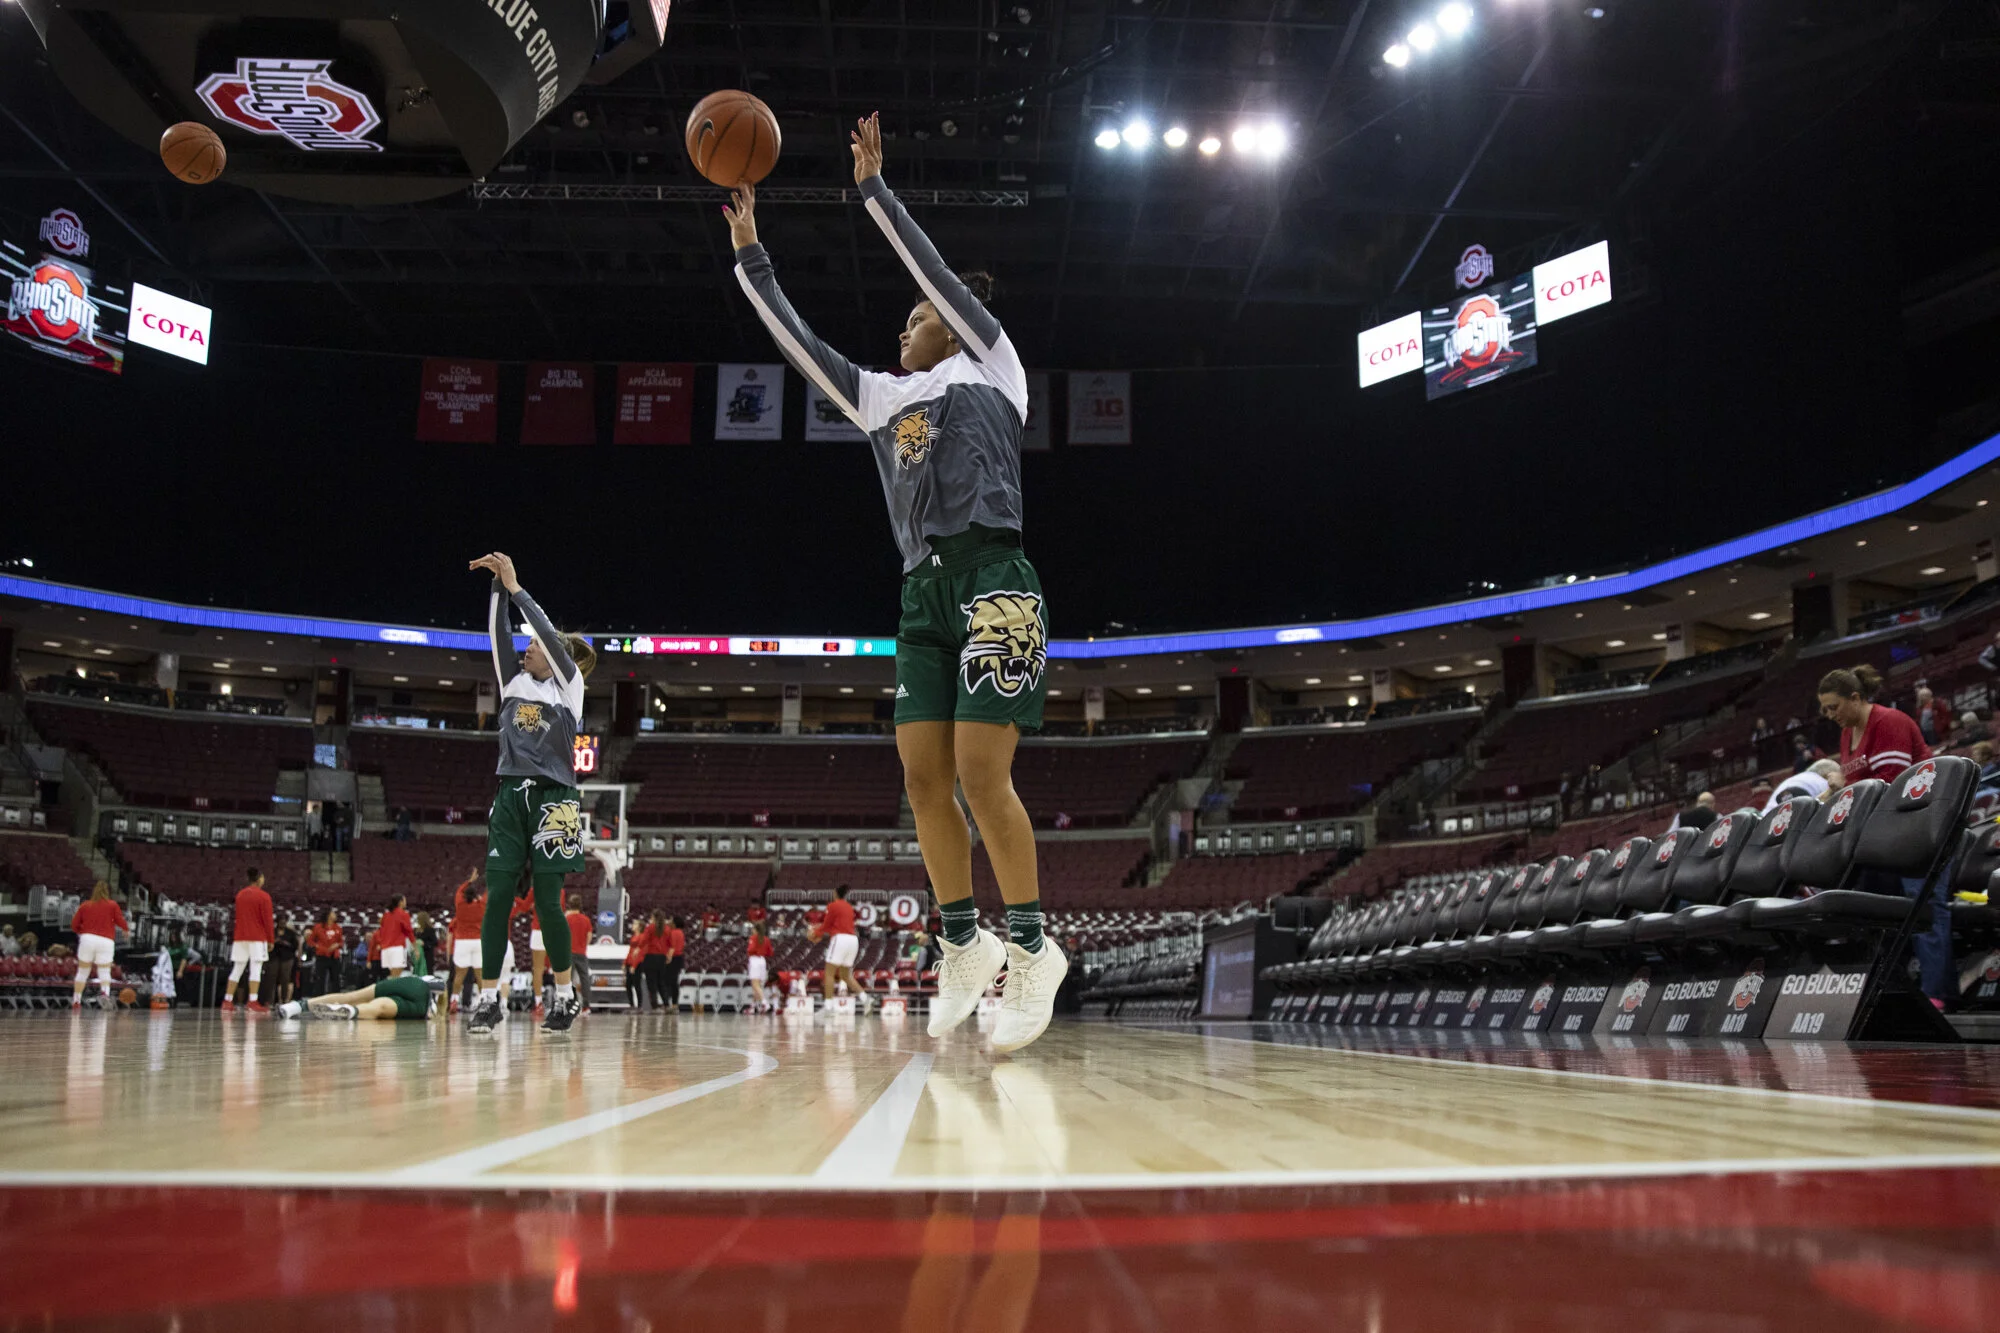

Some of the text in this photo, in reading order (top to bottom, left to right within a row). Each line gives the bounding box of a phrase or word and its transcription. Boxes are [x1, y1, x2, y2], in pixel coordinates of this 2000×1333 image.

[526, 28, 557, 82] CITY
[1546, 270, 1606, 301] COTA
[143, 313, 205, 346] COTA
[1369, 338, 1418, 366] COTA
[438, 374, 482, 385] CHAMPIONS
[547, 369, 578, 379] BIG TEN
[644, 368, 666, 377] NCAA
[540, 378, 584, 388] CHAMPIONS
[628, 377, 683, 388] APPEARANCES
[437, 401, 480, 411] CHAMPIONS
[446, 391, 494, 404] TOURNAMENT
[1662, 983, 1682, 1000] GO
[1679, 979, 1721, 1000] BUCKS!
[1782, 974, 1806, 995] GO
[1804, 973, 1867, 994] BUCKS!
[1666, 1014, 1691, 1032] AA17
[1720, 1013, 1748, 1033] AA18
[1790, 1012, 1825, 1034] AA19
